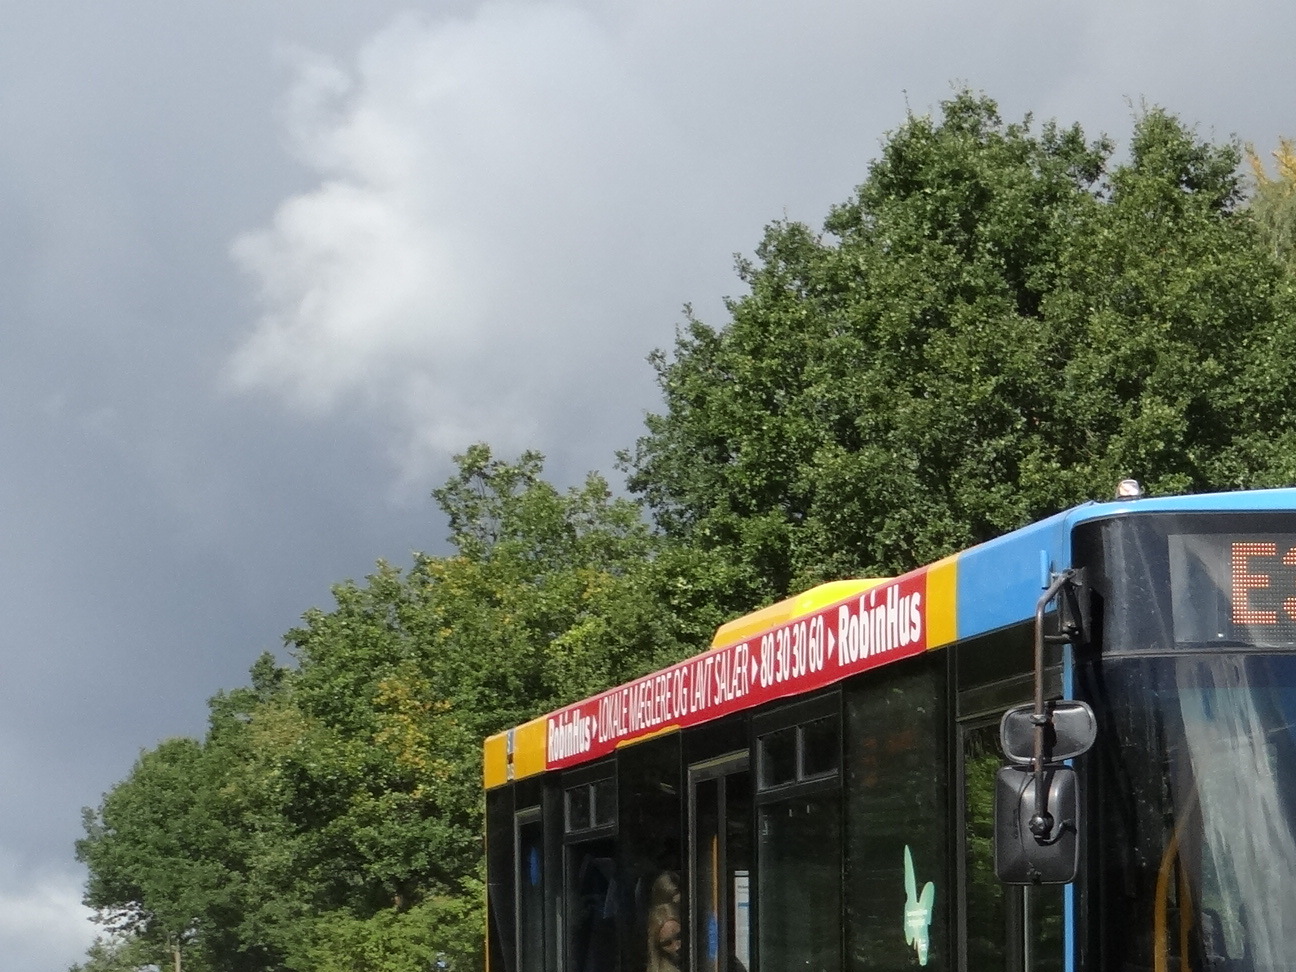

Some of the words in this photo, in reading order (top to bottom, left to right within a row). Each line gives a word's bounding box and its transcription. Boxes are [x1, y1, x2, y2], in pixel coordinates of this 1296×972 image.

[547, 709, 591, 763] RobinHus
[598, 689, 628, 743] LOKALE
[629, 672, 672, 734] MÆGLERE
[673, 666, 689, 718] OG
[690, 656, 714, 713] LAVT
[714, 643, 749, 705] SALÆR
[760, 632, 774, 688] 80
[776, 626, 790, 682] 30
[792, 621, 806, 678] 30
[808, 615, 824, 673] 60
[838, 584, 921, 666] RobinHus
